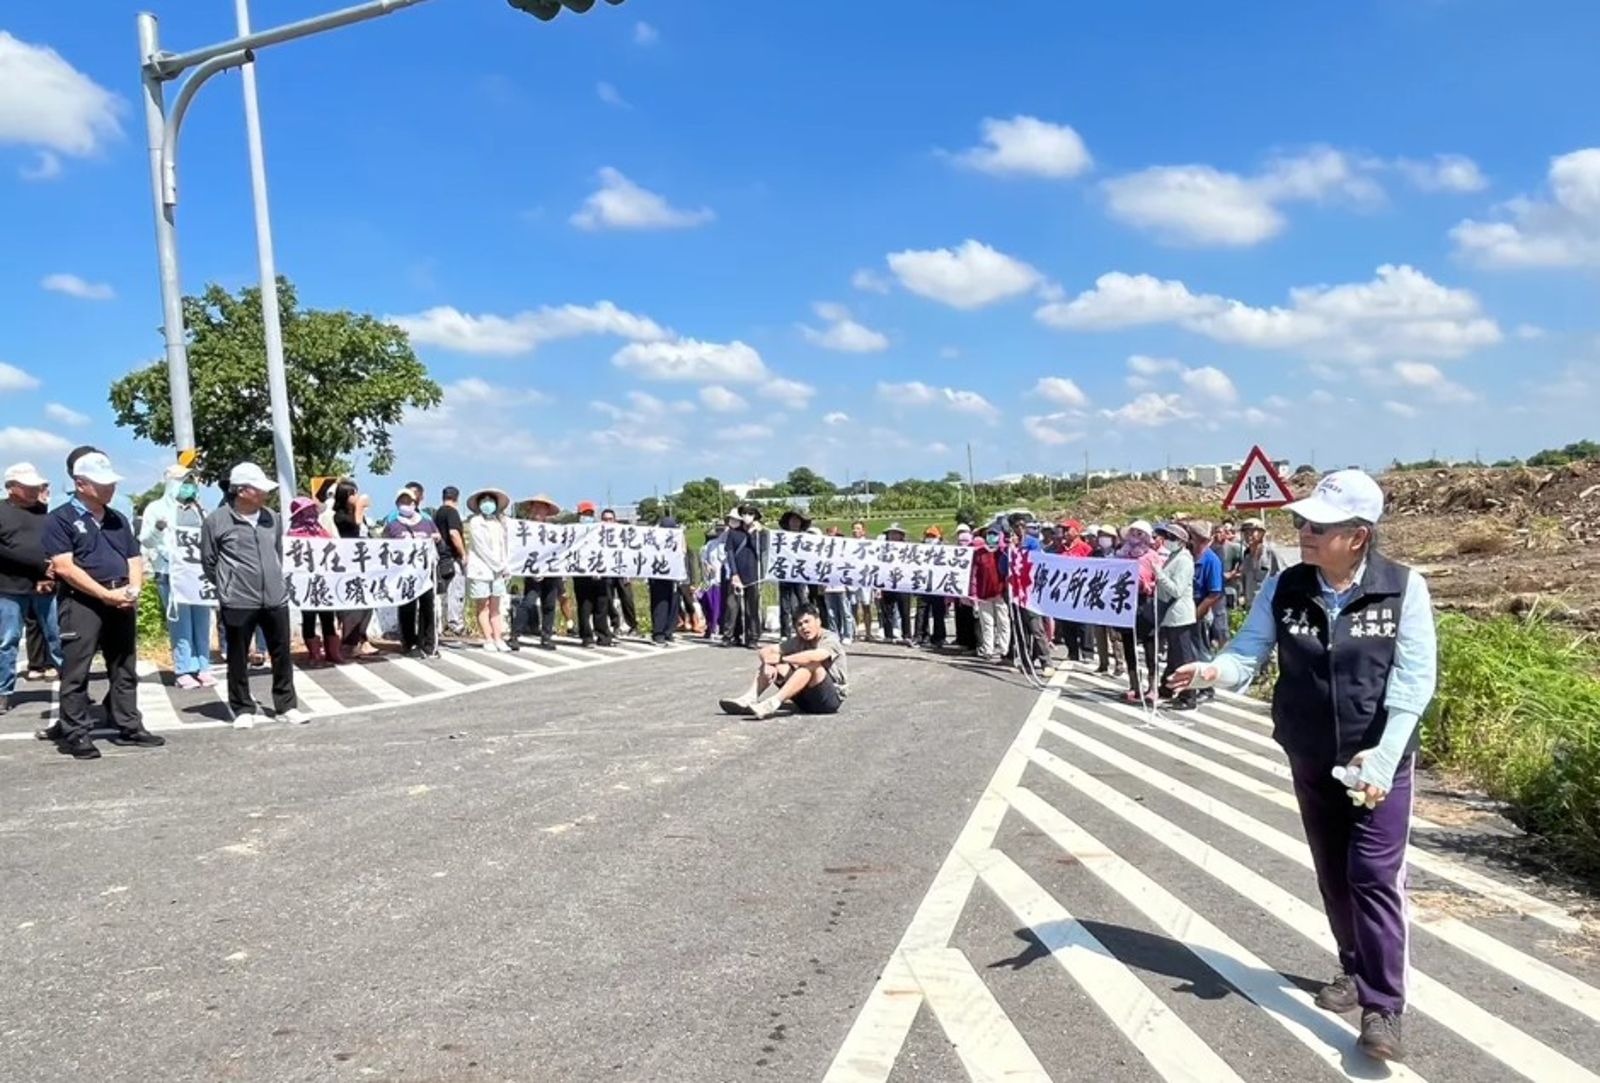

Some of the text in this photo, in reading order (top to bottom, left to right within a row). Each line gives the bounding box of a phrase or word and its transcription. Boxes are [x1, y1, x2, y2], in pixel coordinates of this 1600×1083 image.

[1245, 475, 1271, 501] 慢
[521, 550, 671, 576] 死亡設施集中地
[771, 532, 971, 569] 平和村！不當犧牲品
[767, 556, 964, 595] 居民誓言抗爭到底
